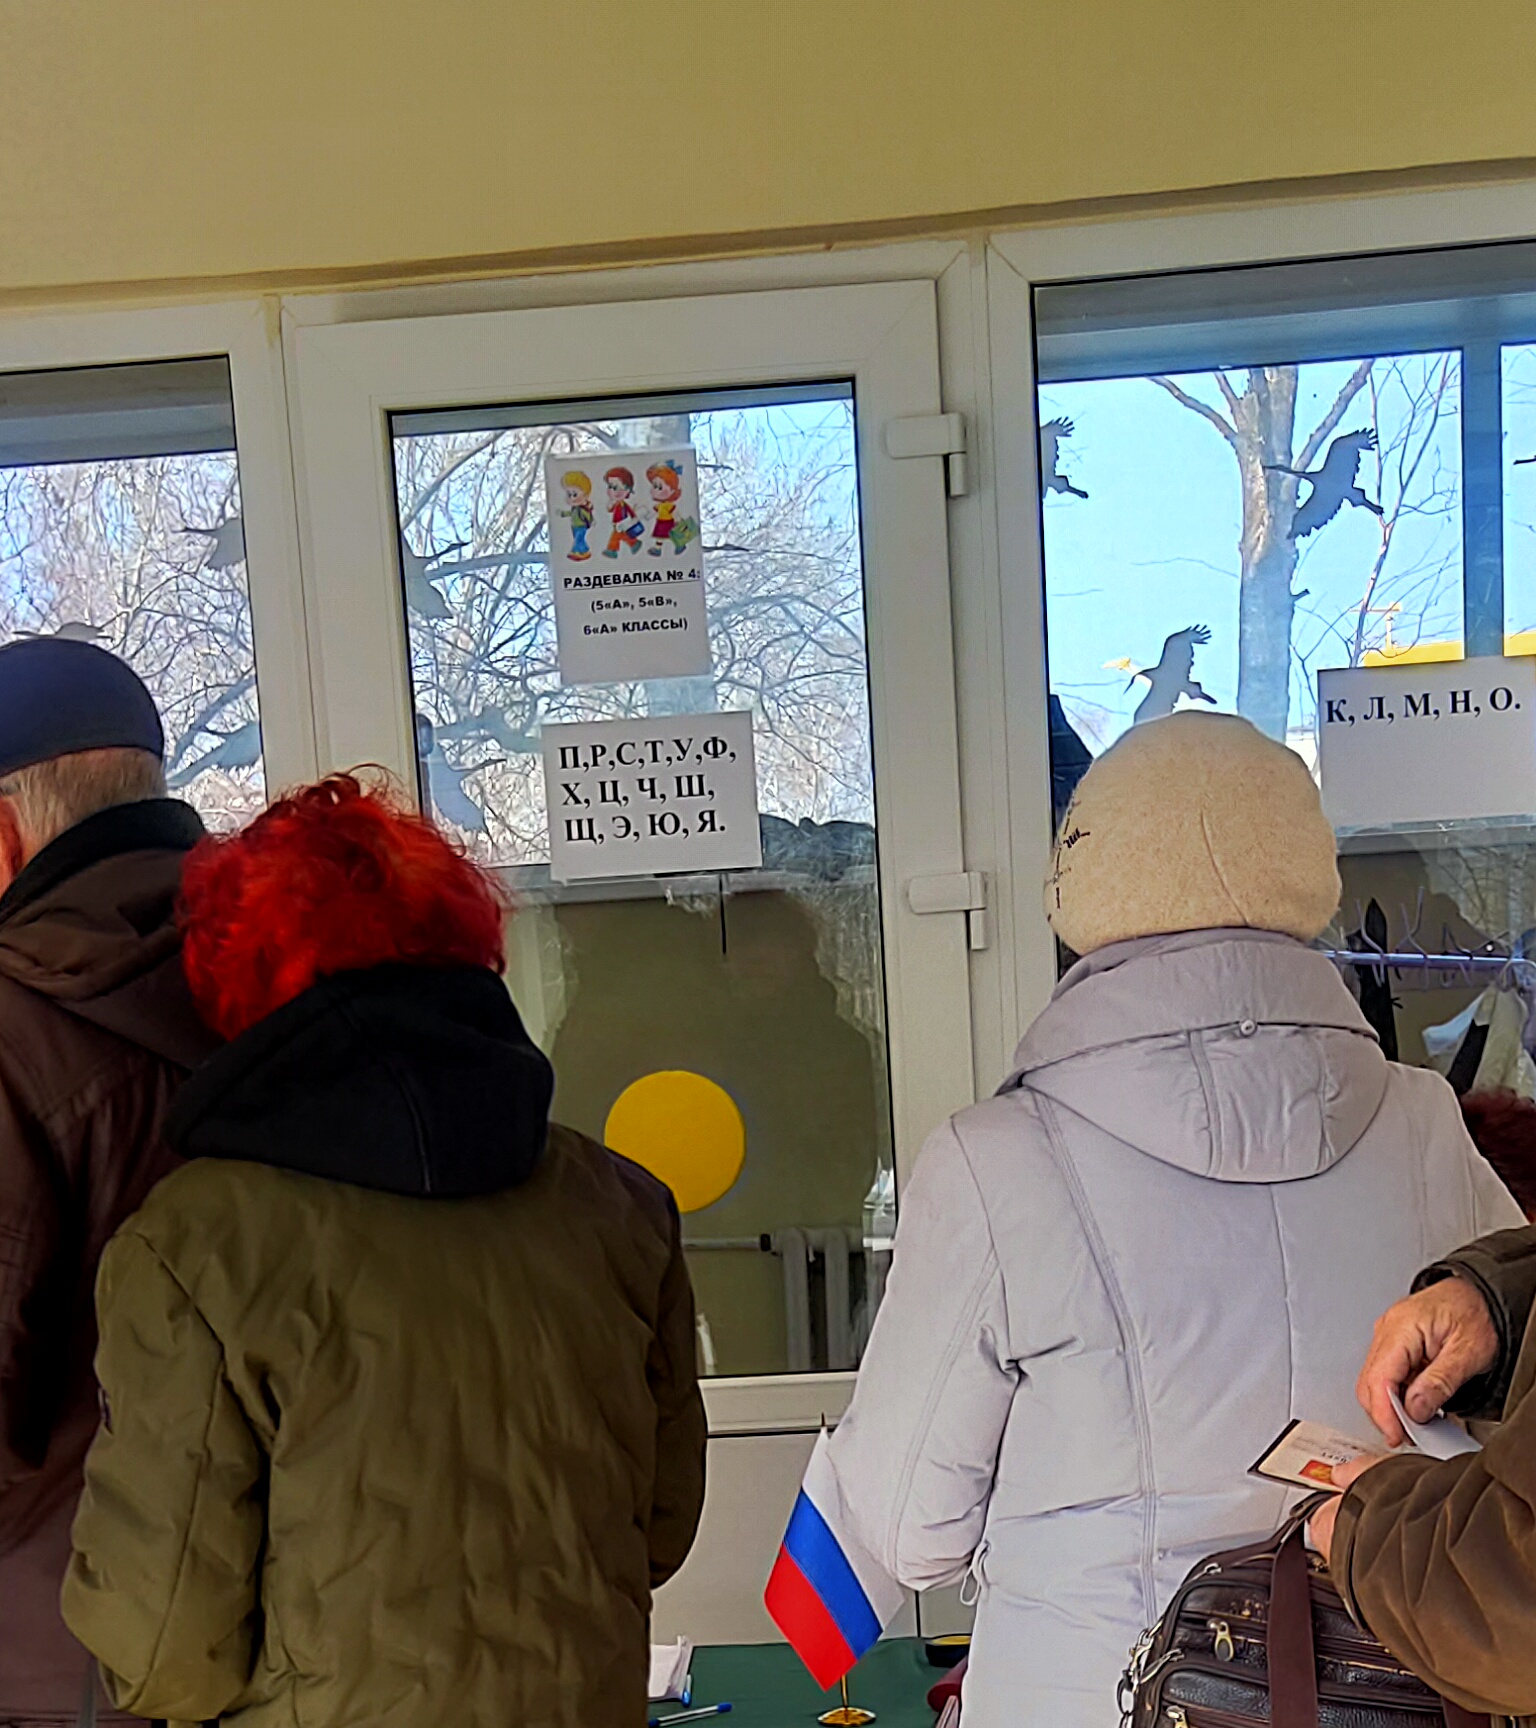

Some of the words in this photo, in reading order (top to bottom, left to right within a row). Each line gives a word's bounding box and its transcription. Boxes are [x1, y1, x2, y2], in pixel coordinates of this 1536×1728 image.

[563, 571, 663, 590] РАЗДЕВАЛКА
[666, 569, 684, 582] №
[621, 617, 688, 633] КЛАССЫ)
[1326, 698, 1355, 726] К,
[1363, 696, 1395, 724] Л,
[1403, 692, 1440, 720] М,
[1449, 689, 1481, 717] Н,
[1489, 687, 1521, 711] О.
[561, 782, 591, 809] Х,
[598, 780, 629, 807] Ц,
[636, 777, 667, 804] Ч,
[674, 774, 715, 801] Ш,
[564, 817, 605, 845] Щ,
[611, 815, 640, 843] Э,
[648, 812, 689, 839] Ю,
[696, 809, 726, 833] Я.
